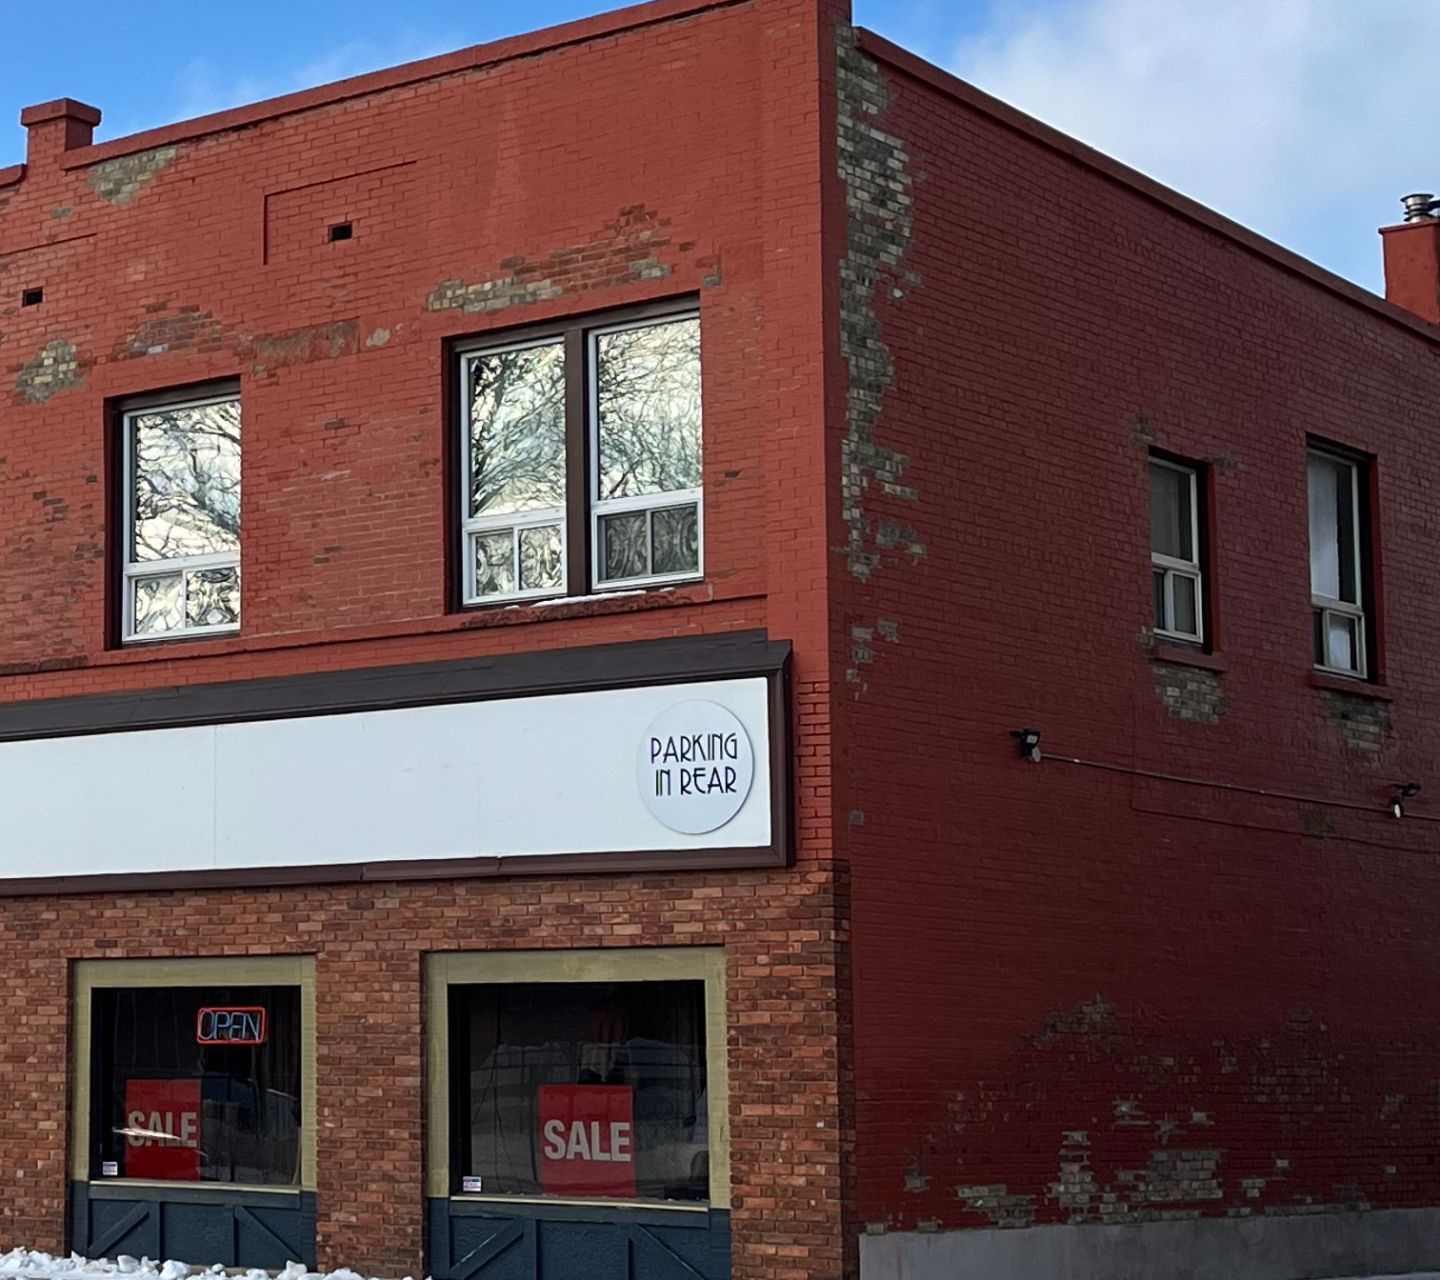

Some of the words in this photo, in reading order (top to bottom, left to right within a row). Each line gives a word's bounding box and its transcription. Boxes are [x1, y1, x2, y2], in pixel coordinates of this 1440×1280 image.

[650, 732, 738, 764] PARKING
[655, 768, 671, 797] IN
[680, 766, 737, 795] REAR
[199, 1010, 261, 1041] OPEN
[128, 1110, 198, 1148] SALE
[543, 1119, 632, 1162] SALE
